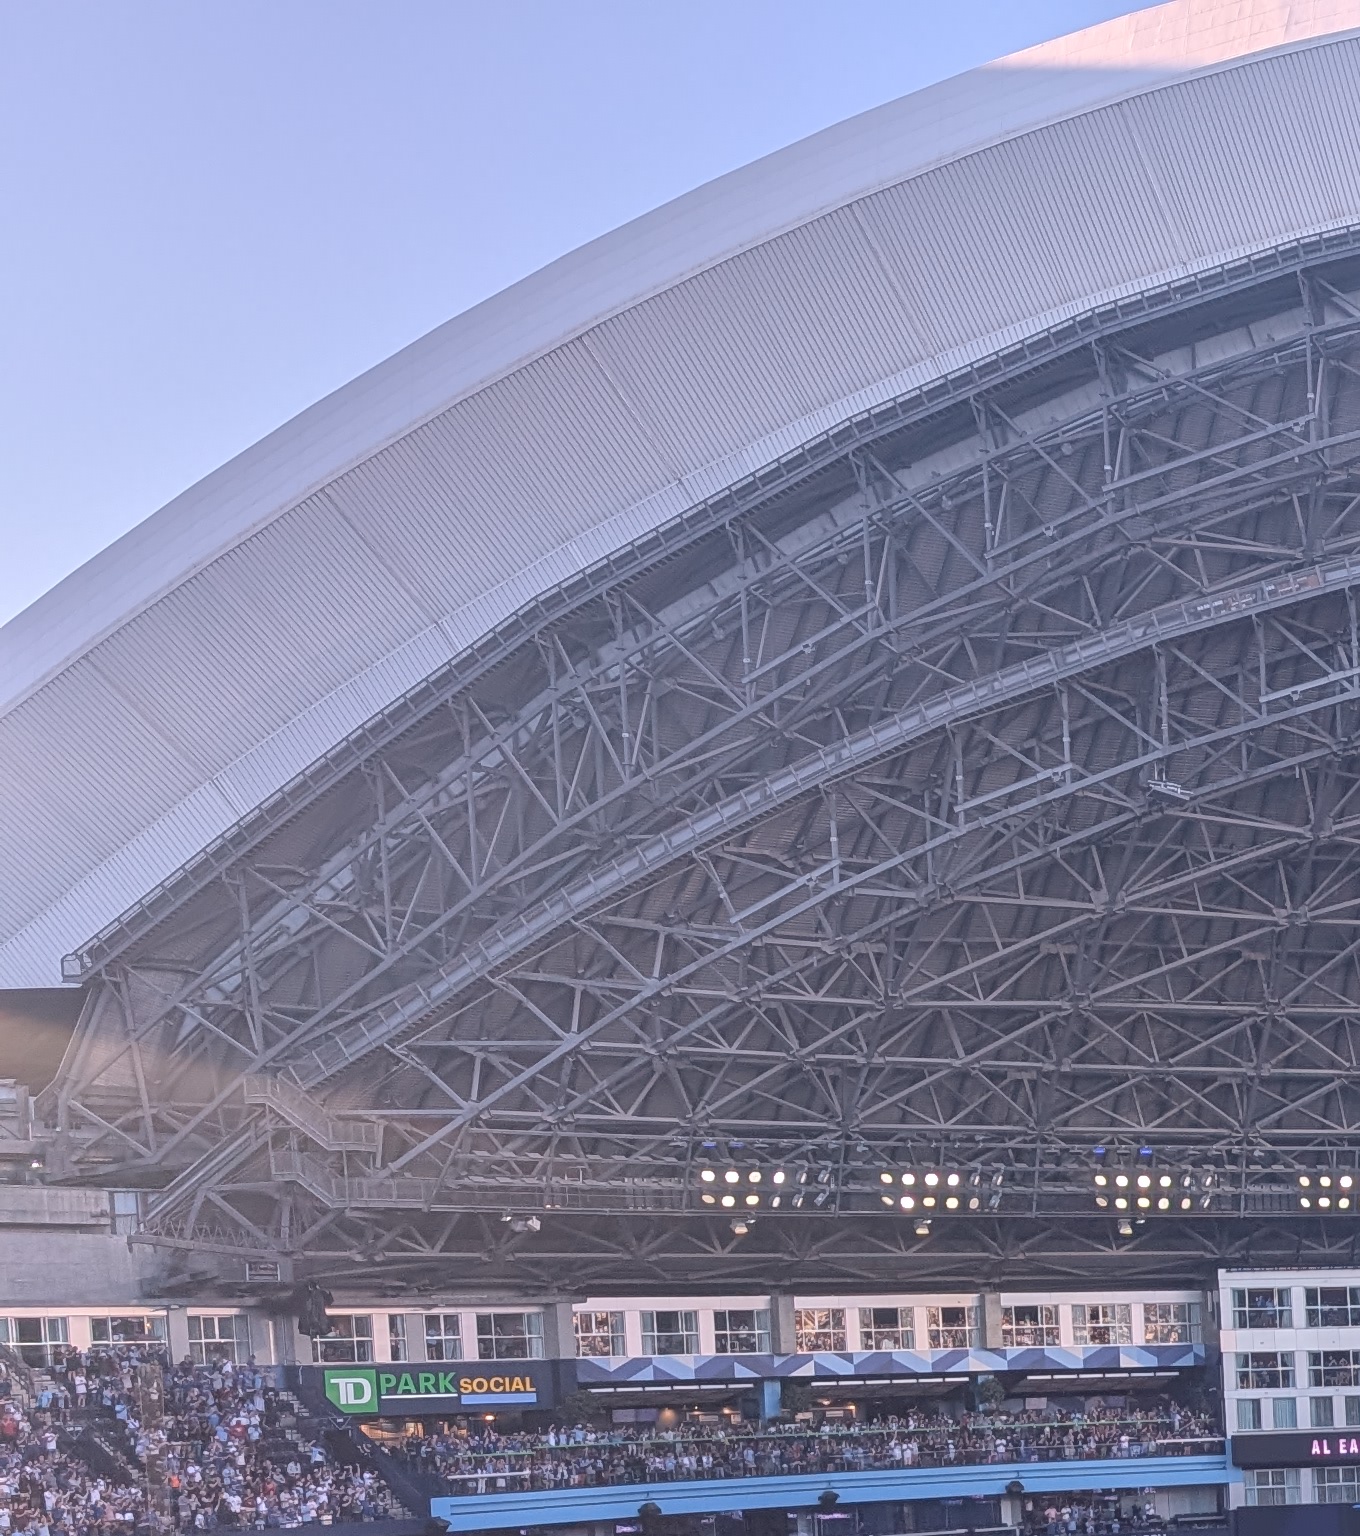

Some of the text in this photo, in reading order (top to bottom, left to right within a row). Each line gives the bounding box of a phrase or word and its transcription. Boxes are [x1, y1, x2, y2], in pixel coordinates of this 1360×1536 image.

[330, 1372, 537, 1405] TD PARK SOCIAL
[1311, 1439, 1331, 1455] AL
